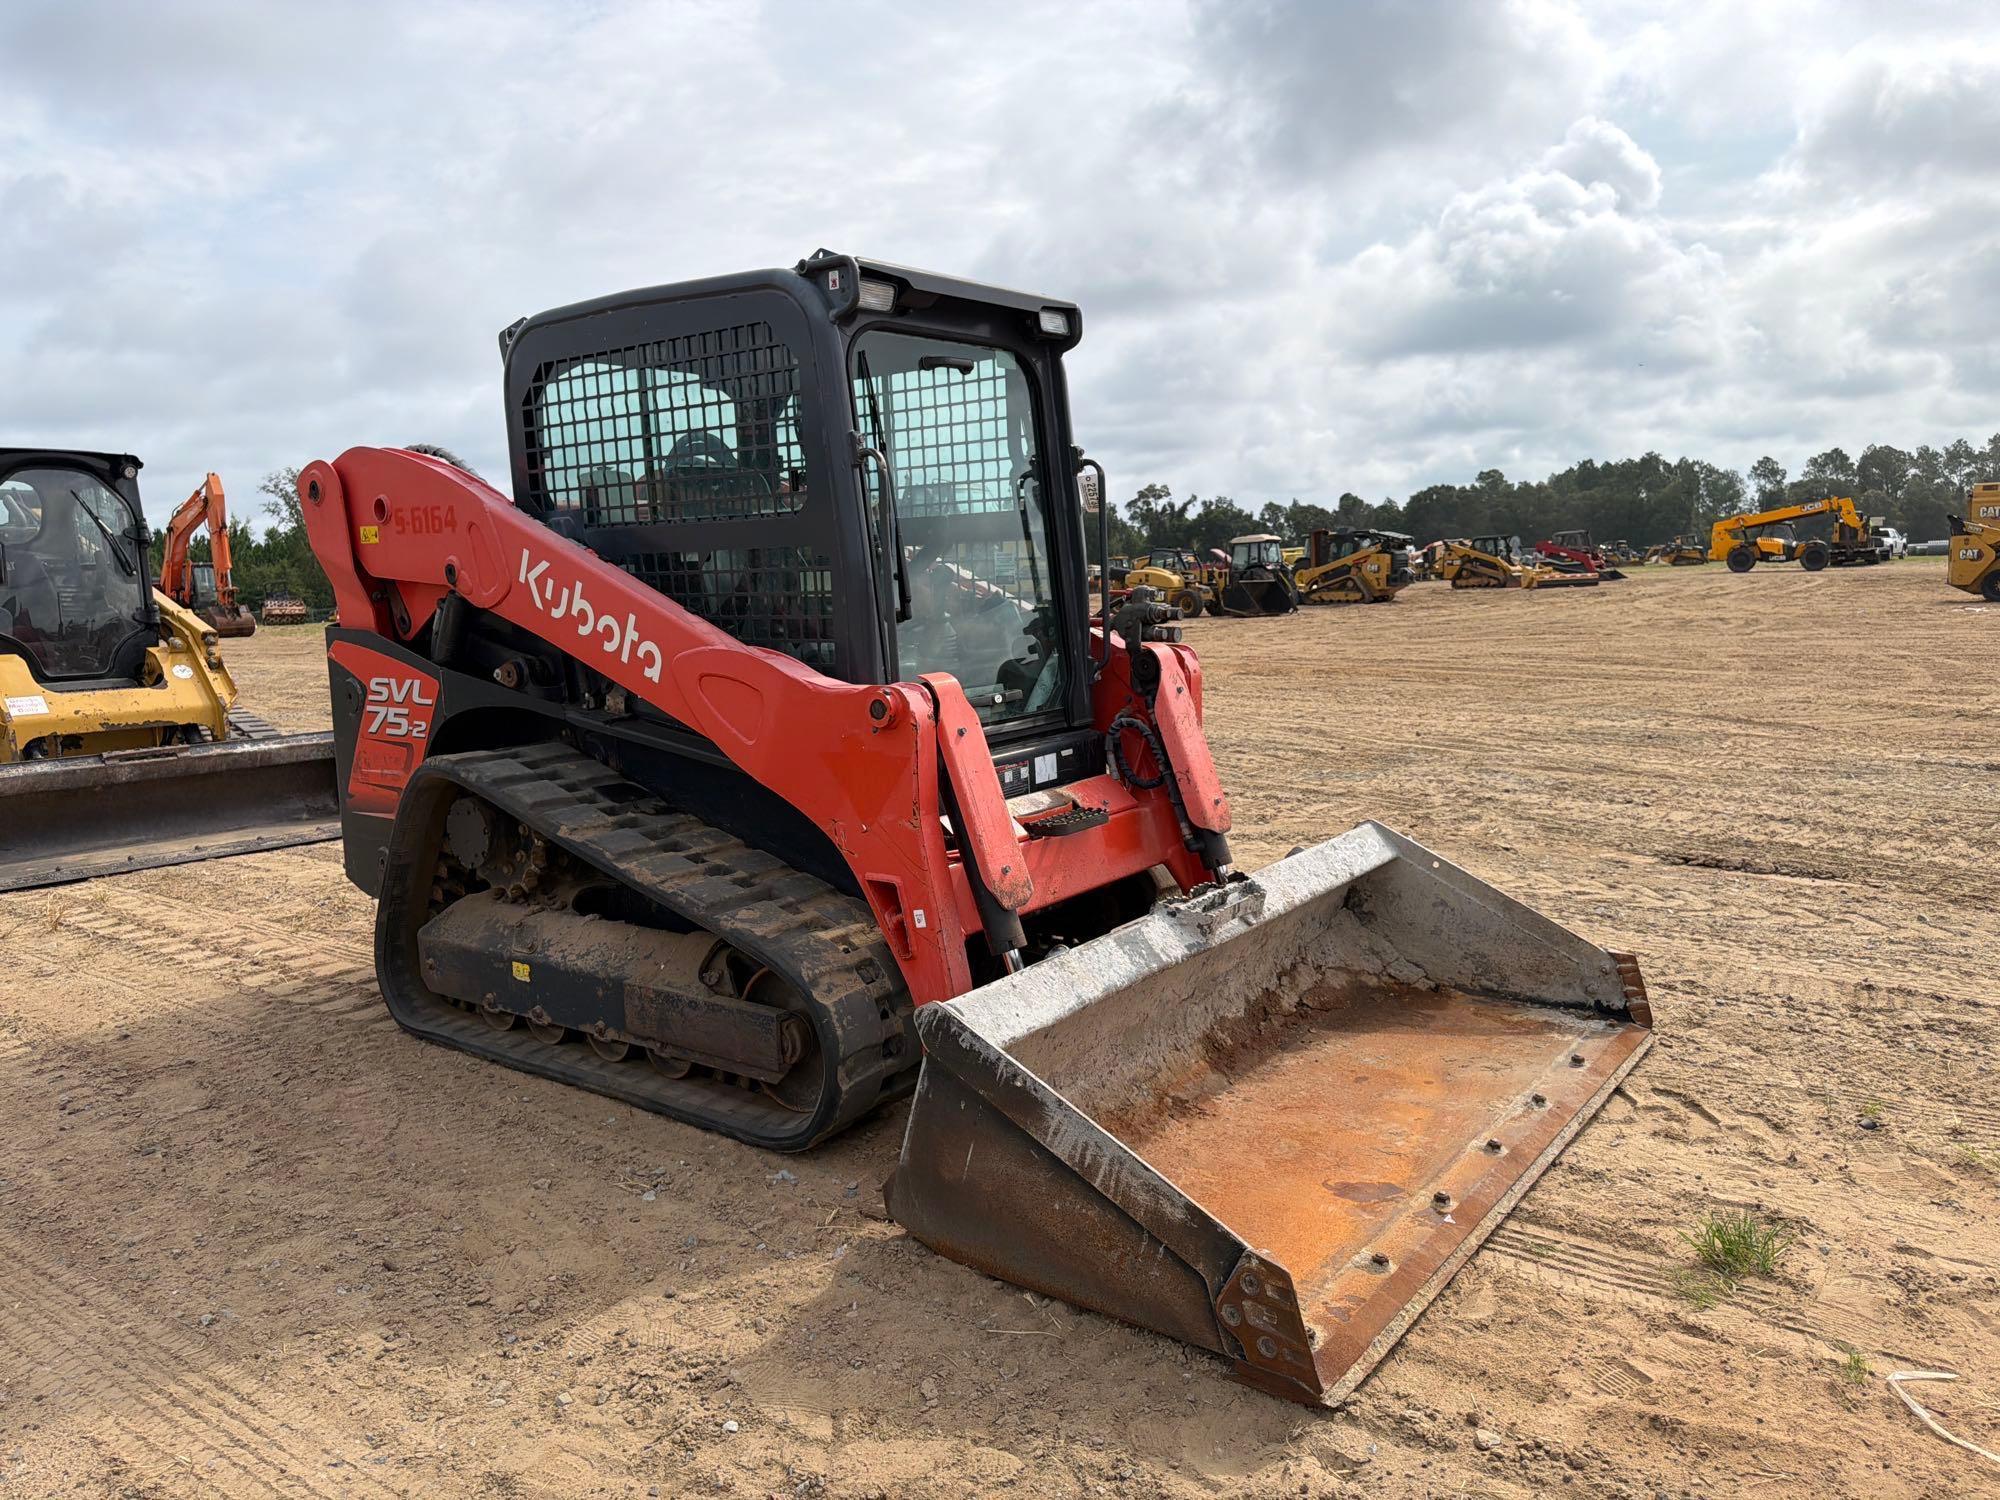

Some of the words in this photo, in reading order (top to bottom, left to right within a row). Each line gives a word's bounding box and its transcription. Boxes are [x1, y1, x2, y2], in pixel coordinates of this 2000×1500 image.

[1801, 502, 1823, 512] JCB
[1959, 549, 1979, 560] CAT
[518, 548, 663, 684] Kubota
[368, 677, 433, 705] SVL
[366, 705, 428, 738] 75-2
